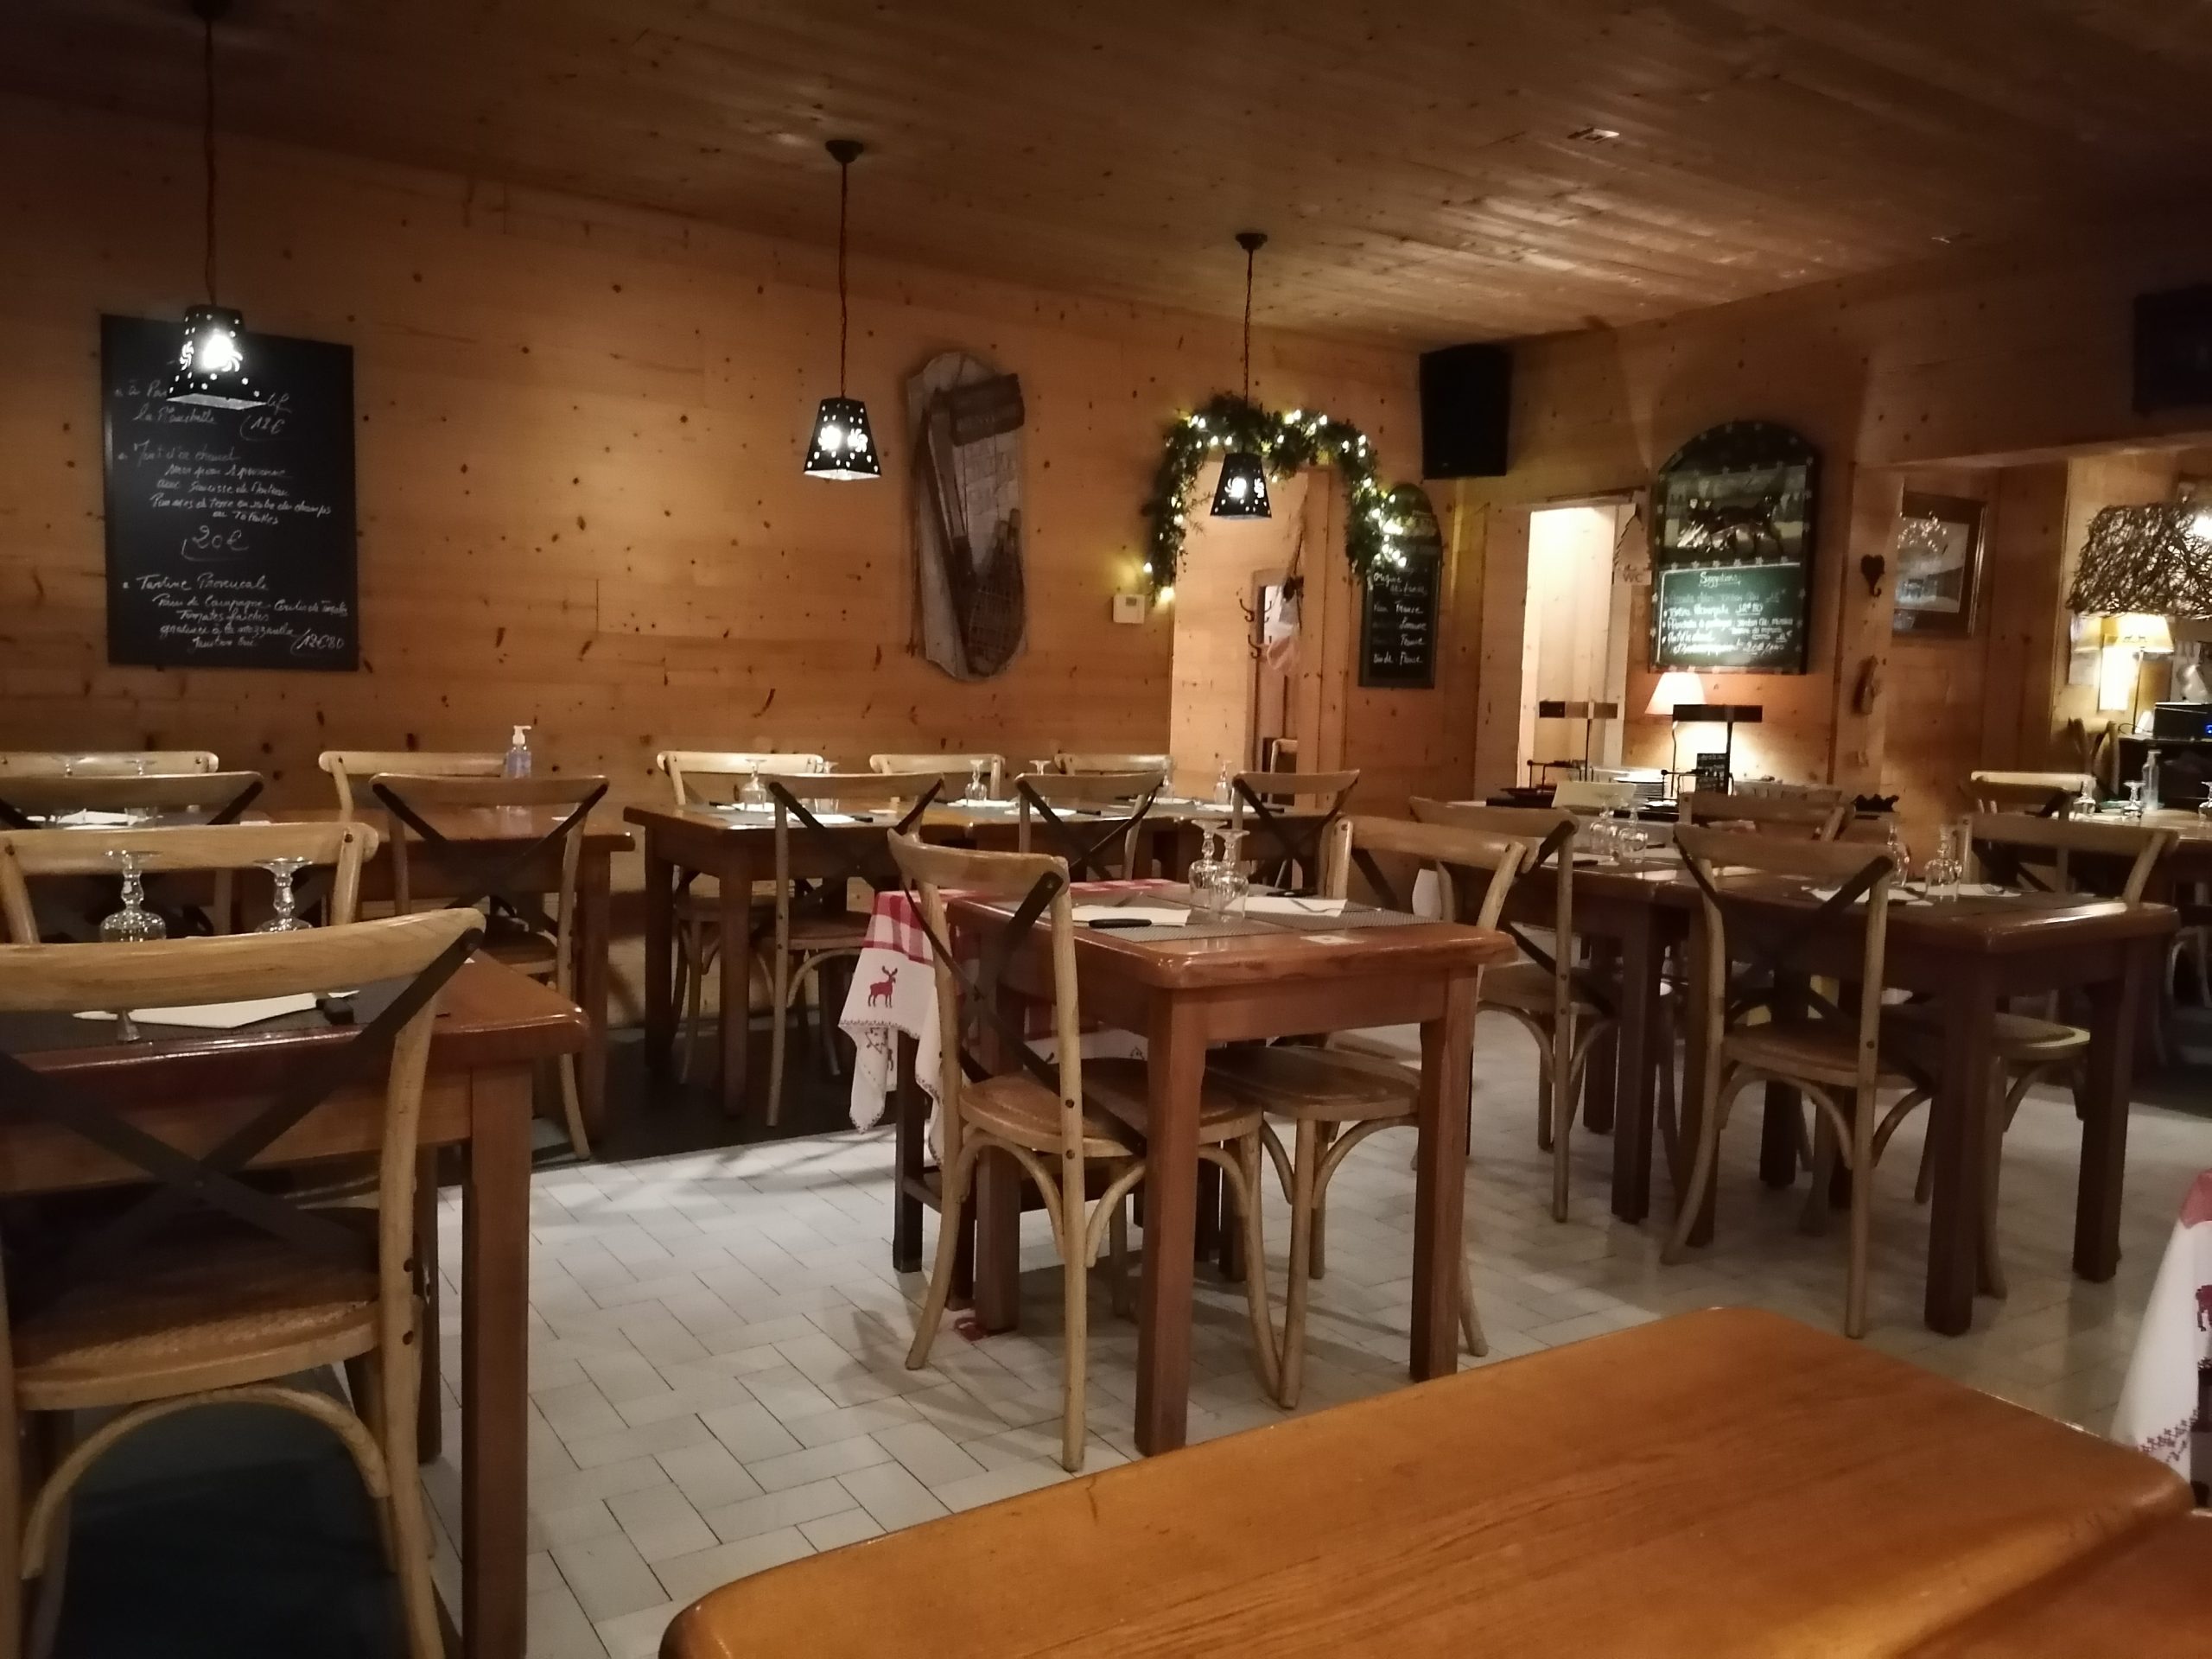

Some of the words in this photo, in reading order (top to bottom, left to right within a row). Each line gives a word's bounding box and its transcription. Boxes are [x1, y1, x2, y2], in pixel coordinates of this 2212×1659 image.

[136, 574, 192, 591] Tartine
[1623, 573, 1644, 583] WC
[175, 608, 224, 623] Tomates
